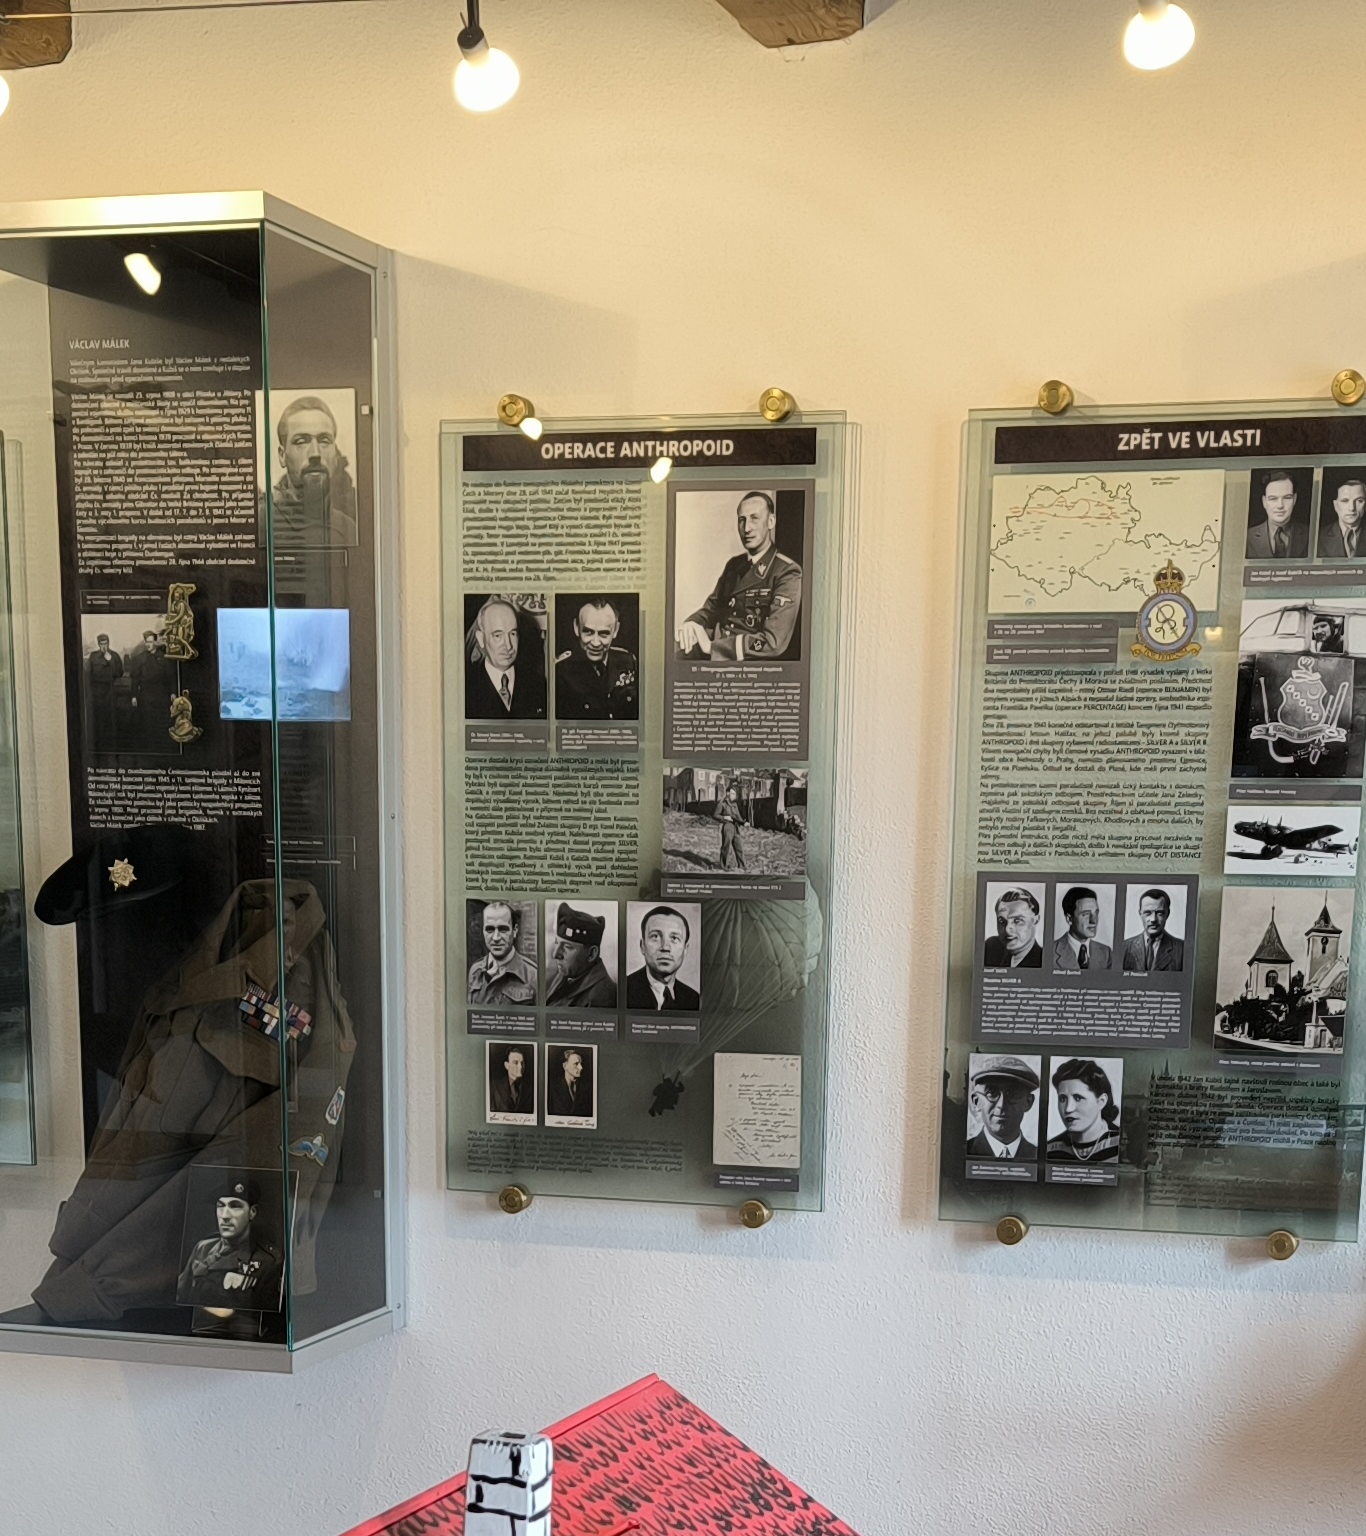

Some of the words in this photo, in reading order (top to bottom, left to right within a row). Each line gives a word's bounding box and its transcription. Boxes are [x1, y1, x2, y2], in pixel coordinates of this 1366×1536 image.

[69, 338, 99, 350] VÁCLAV
[1117, 426, 1162, 451] ZPĚT
[1168, 431, 1191, 450] VE
[1197, 429, 1261, 448] VLASTI
[541, 441, 615, 459] OPERACE
[620, 439, 734, 458] ANTHROPOID
